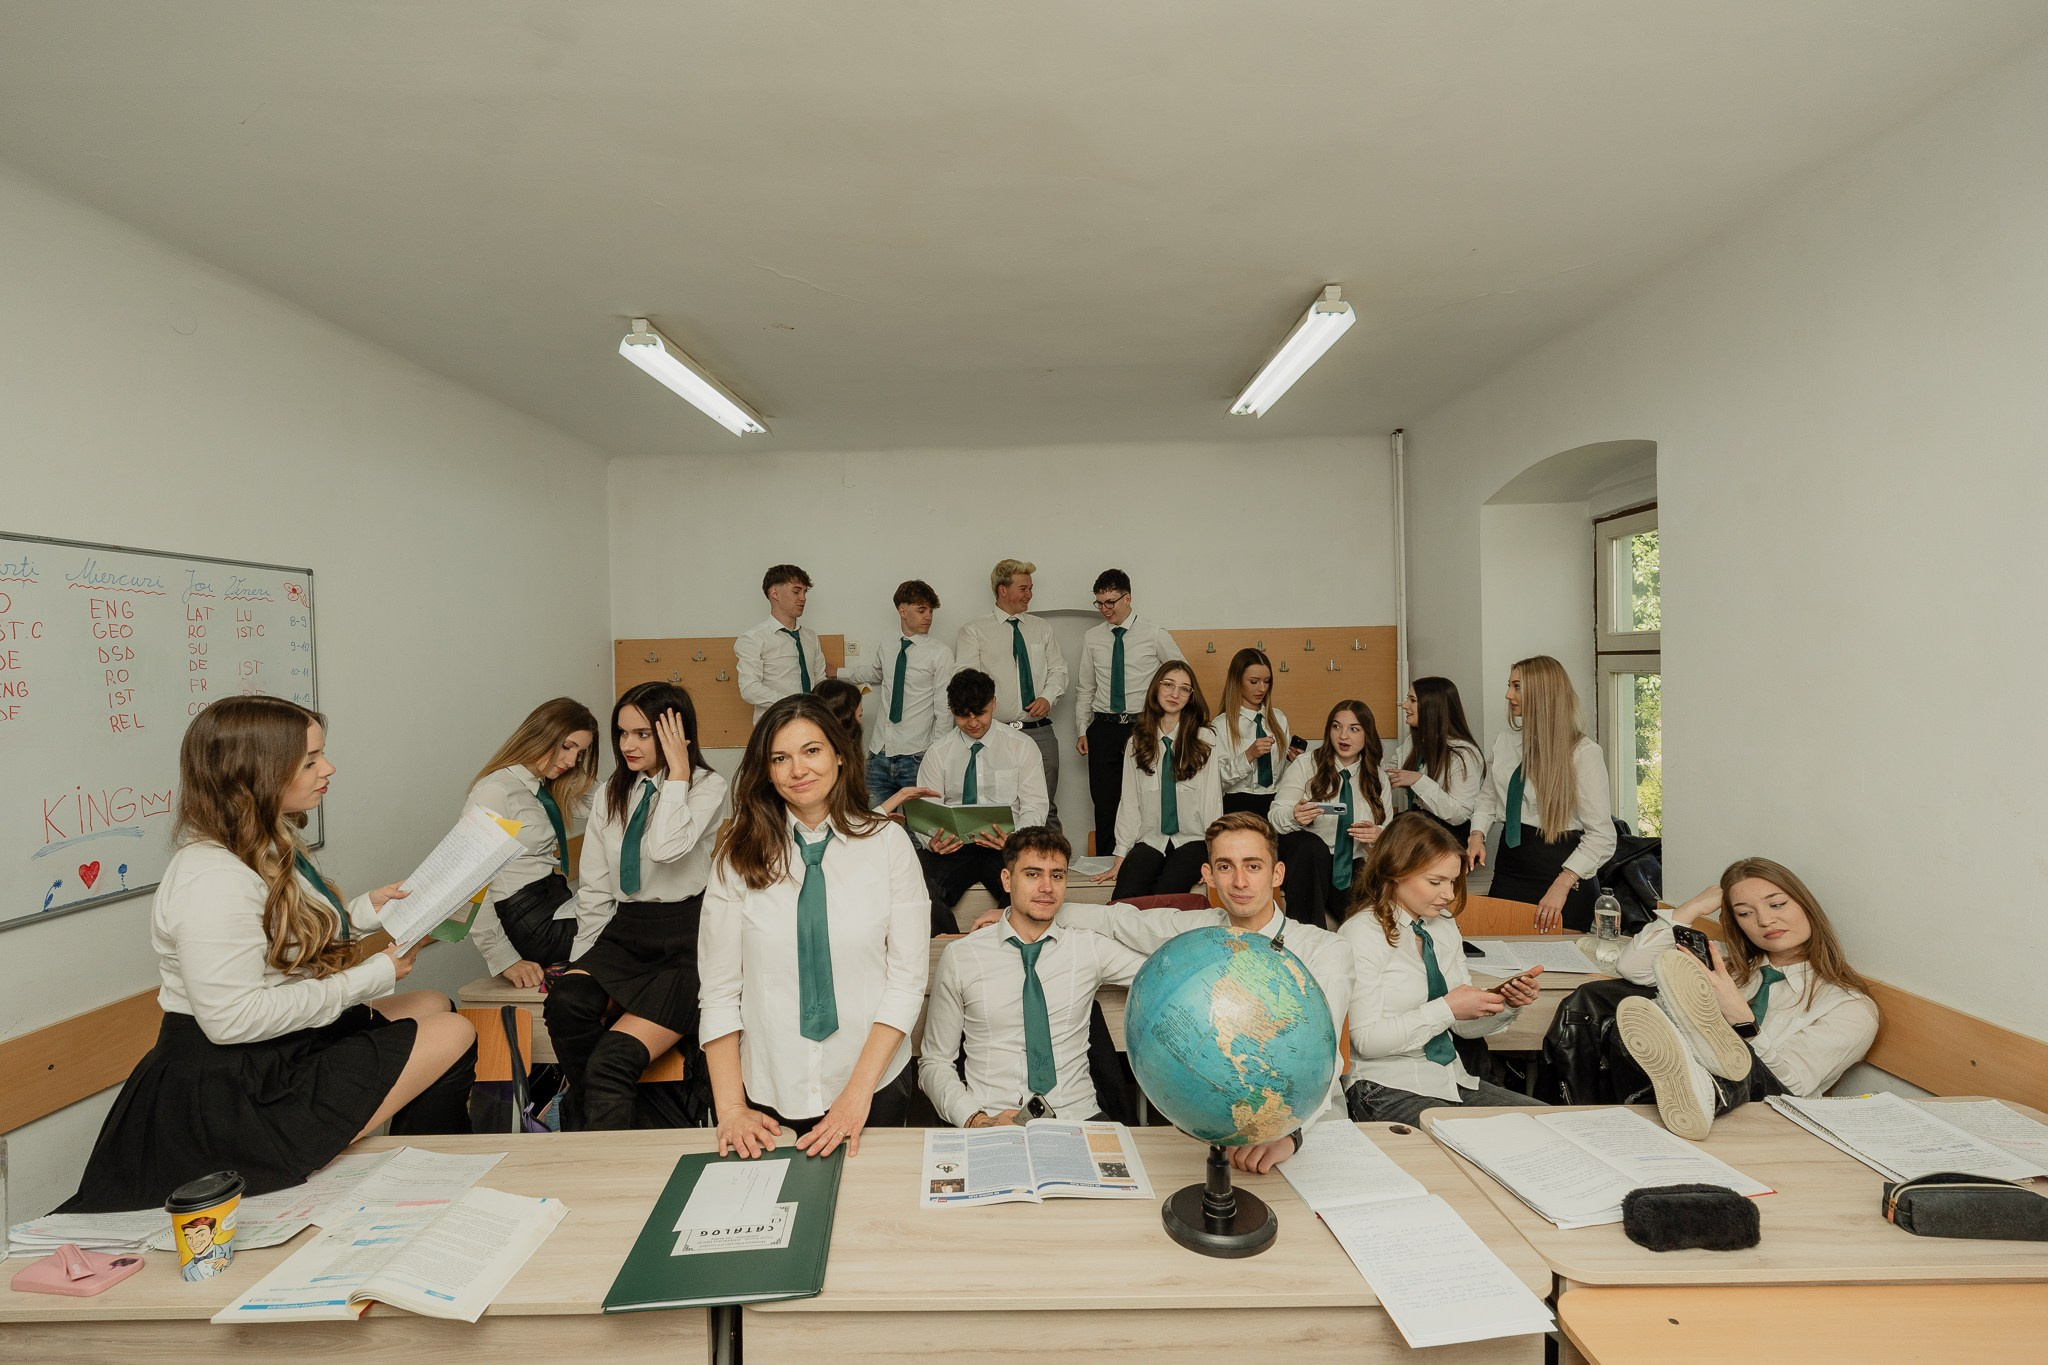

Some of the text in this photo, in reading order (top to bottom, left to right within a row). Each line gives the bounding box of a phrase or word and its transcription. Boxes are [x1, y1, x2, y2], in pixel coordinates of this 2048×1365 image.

[65, 557, 164, 588] Miercuri
[182, 569, 213, 603] Joi
[224, 575, 271, 596] Vineri
[90, 598, 134, 619] ENG
[186, 603, 215, 622] LAT
[236, 607, 252, 622] LU
[289, 615, 307, 628] 8-9
[93, 622, 133, 639] GEO
[188, 624, 206, 639] RO
[98, 645, 135, 664] DSD
[188, 642, 208, 655] SU
[189, 659, 208, 672] DE
[238, 659, 264, 676] IST
[105, 669, 130, 686] RO
[189, 677, 207, 693] FR
[108, 688, 136, 709] IST
[188, 702, 210, 715] CO
[109, 713, 145, 733] REL
[700, 1225, 774, 1237] CATALOG
